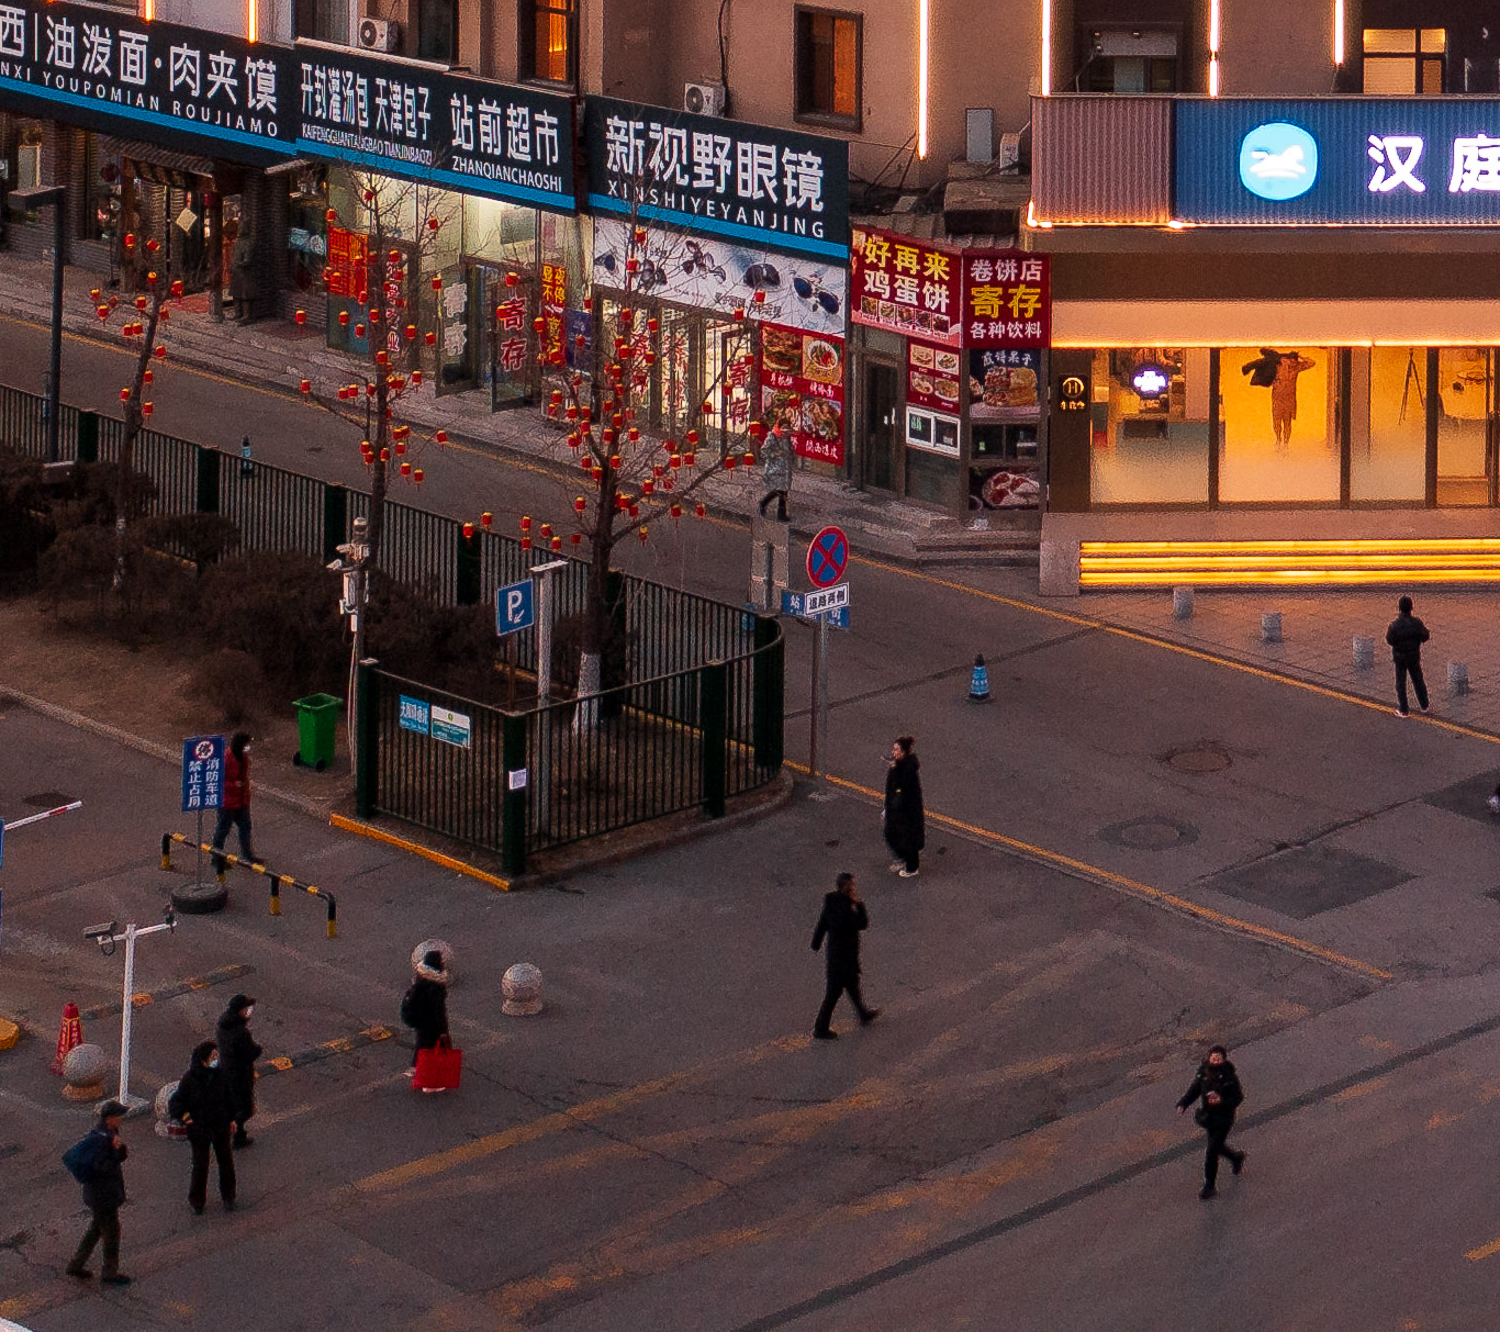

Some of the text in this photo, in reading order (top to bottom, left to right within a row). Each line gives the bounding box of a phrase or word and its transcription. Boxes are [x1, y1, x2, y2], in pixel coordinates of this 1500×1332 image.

[42, 70, 161, 113] YOUPOMIAN
[172, 99, 279, 139] ROUJIAMO
[300, 62, 560, 166] 开封灌汤包 天津包子 站前超市
[452, 155, 562, 193] ZHANQIANCHAOSHI
[605, 113, 825, 213] 新视野眼镜
[607, 178, 825, 239] XINSHIYEYANJING
[863, 235, 951, 281] 好再来
[969, 257, 1043, 283] 卷饼店
[863, 268, 951, 315] 鸡蛋饼
[969, 283, 1043, 320] 寄存
[969, 320, 1043, 340] 各种饮料
[507, 589, 523, 622] P
[187, 758, 220, 808] 消防车道 禁止占用
